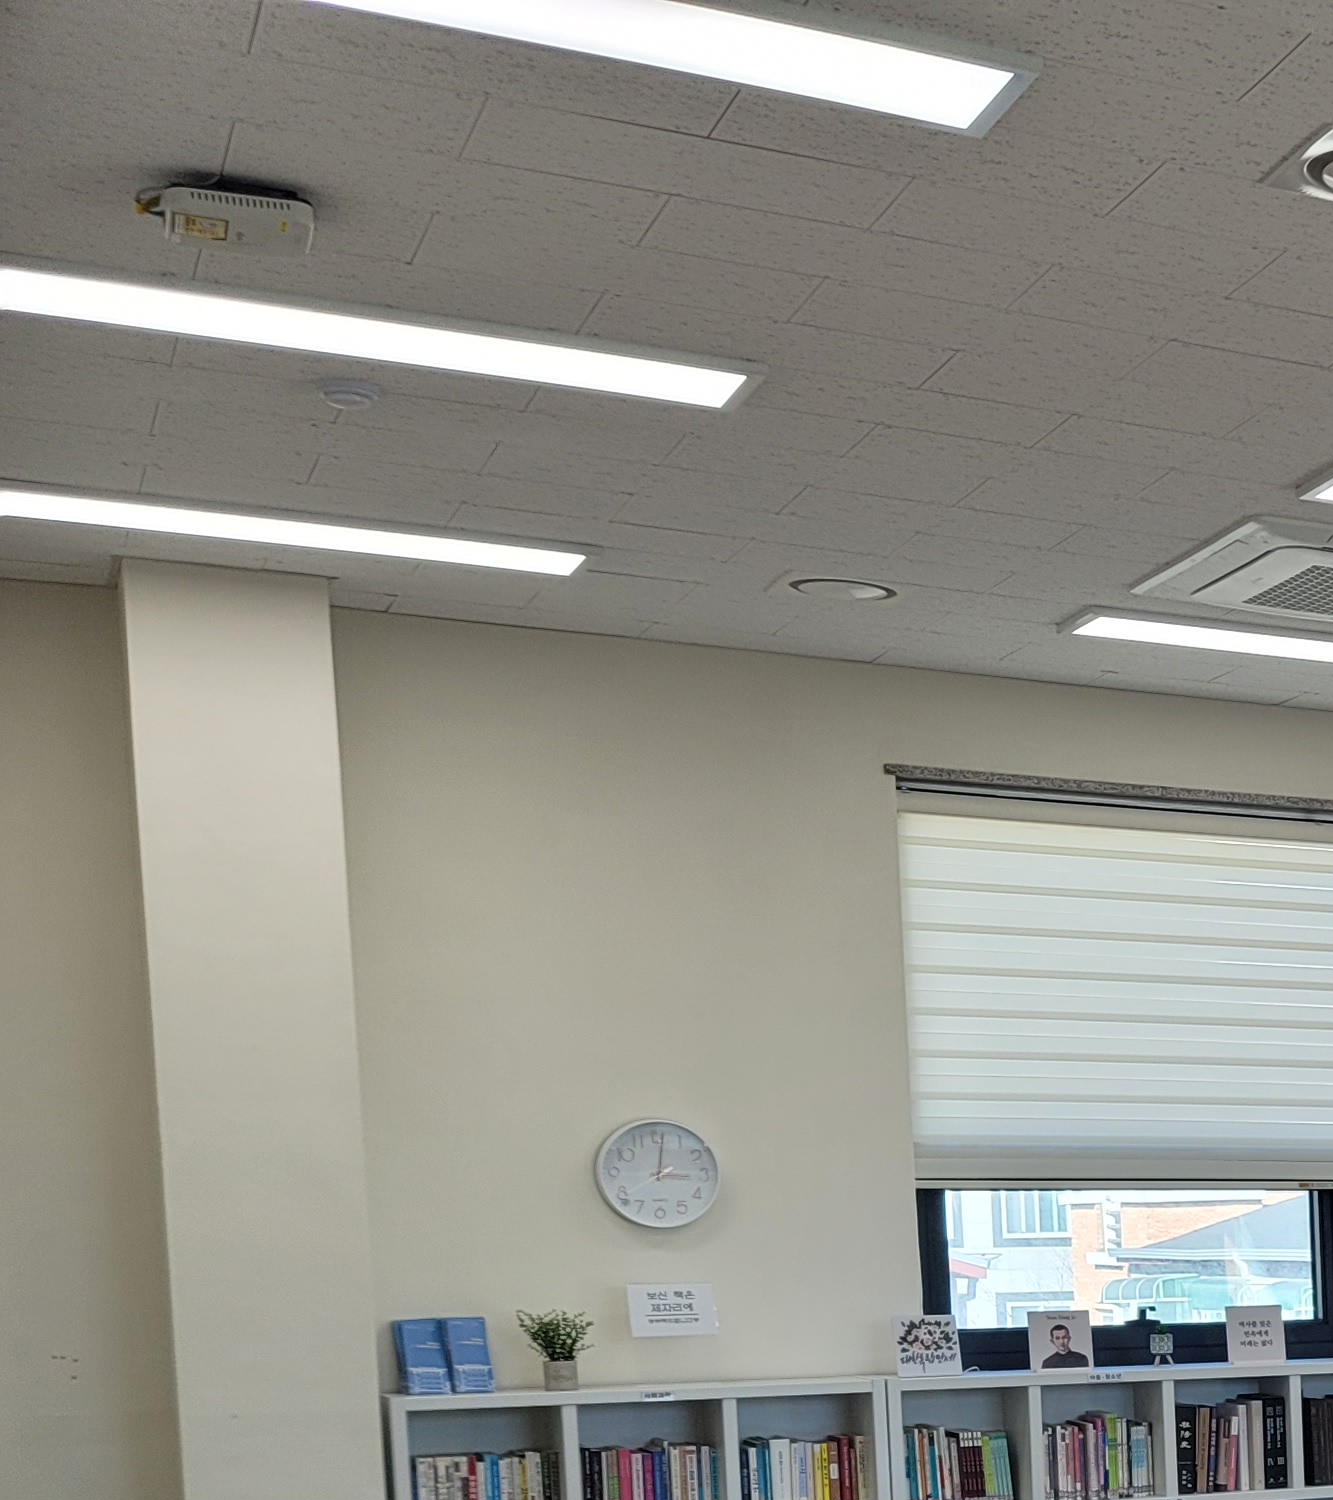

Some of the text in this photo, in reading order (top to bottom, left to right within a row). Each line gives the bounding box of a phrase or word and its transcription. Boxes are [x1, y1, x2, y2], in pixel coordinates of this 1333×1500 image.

[691, 1149, 702, 1163] 2
[699, 1167, 709, 1182] 3
[692, 1186, 702, 1200] 4
[634, 1200, 646, 1214] 7
[654, 1205, 666, 1219] 6
[677, 1200, 688, 1215] 5
[647, 1291, 668, 1301] 보신
